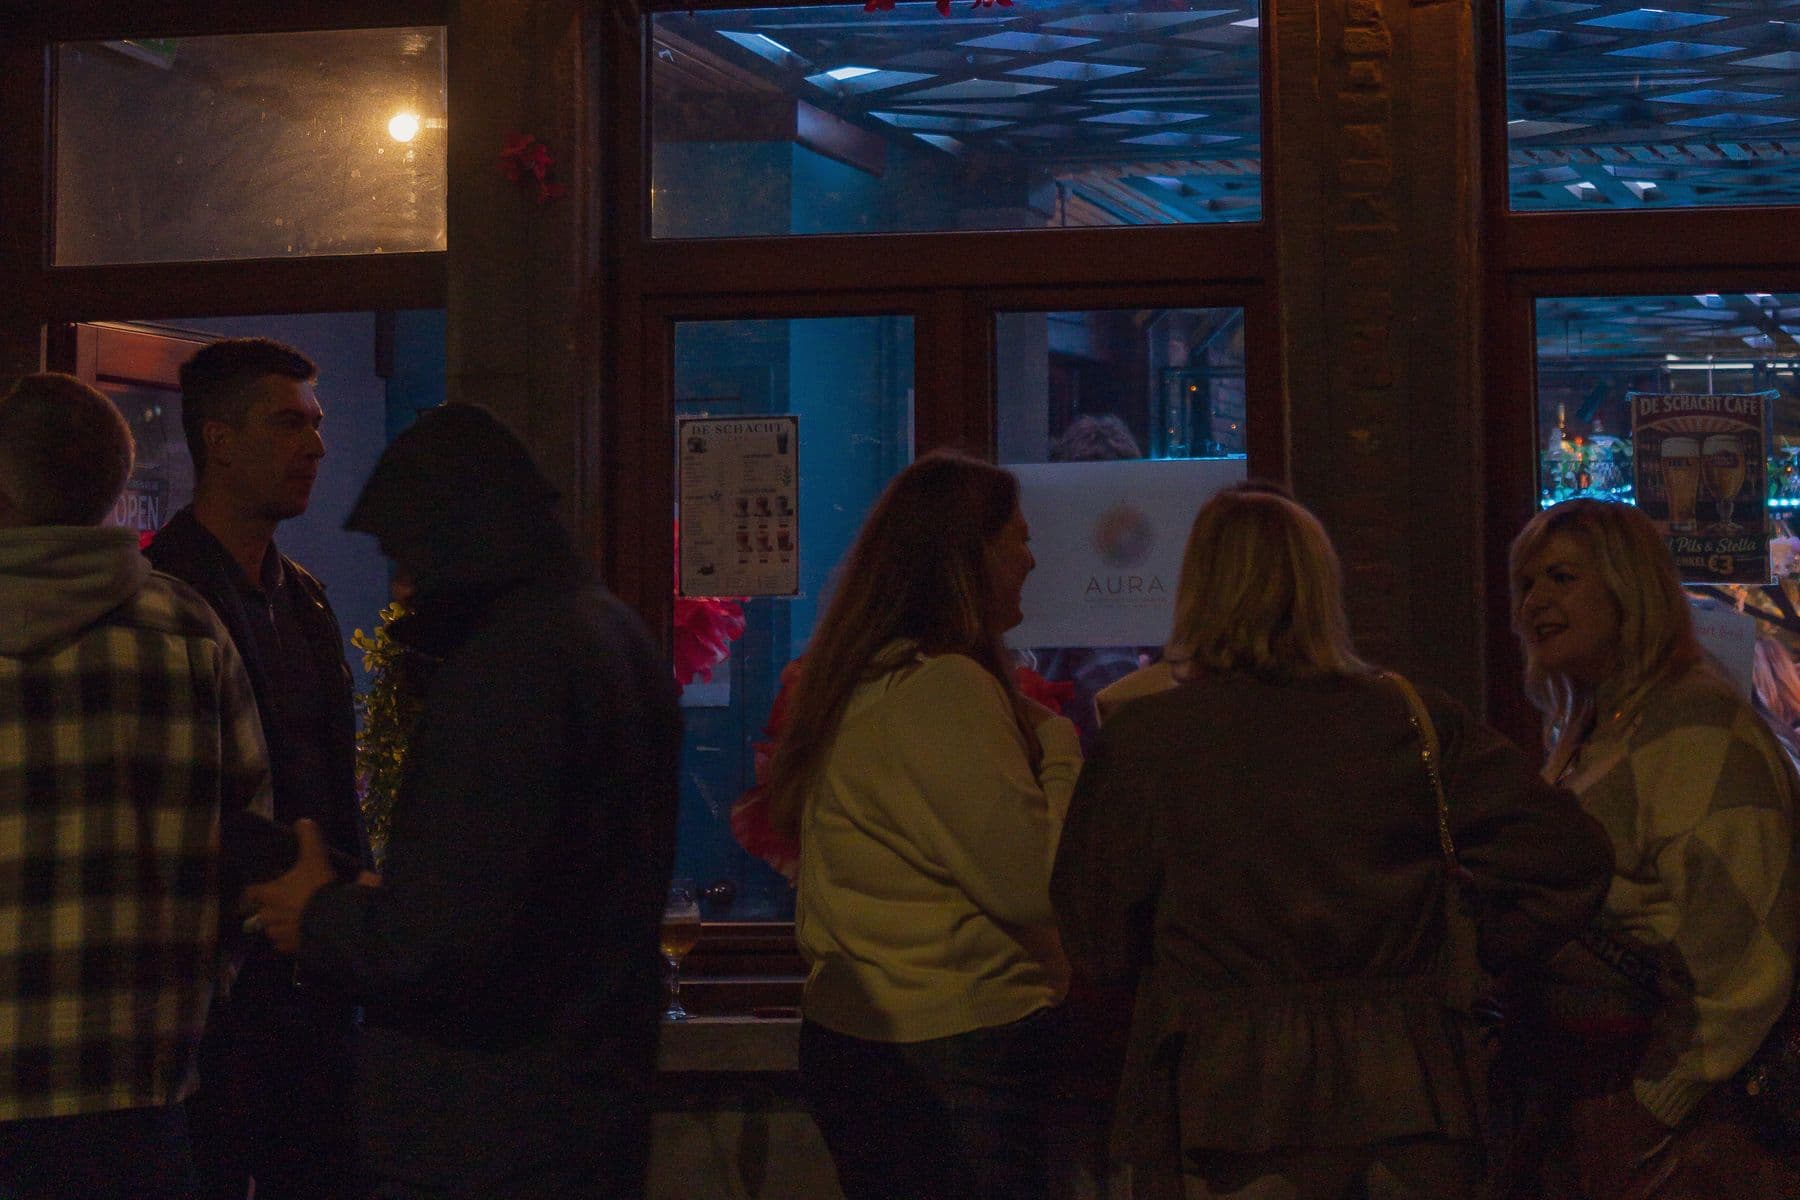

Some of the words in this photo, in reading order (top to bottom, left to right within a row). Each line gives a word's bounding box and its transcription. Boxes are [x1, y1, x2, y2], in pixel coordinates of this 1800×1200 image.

[1640, 398, 1660, 416] DE
[1663, 396, 1721, 413] SCHACHT
[692, 424, 710, 435] DE
[713, 422, 785, 435] SCHACHT
[115, 496, 160, 529] OPEN
[1086, 576, 1165, 594] AURA
